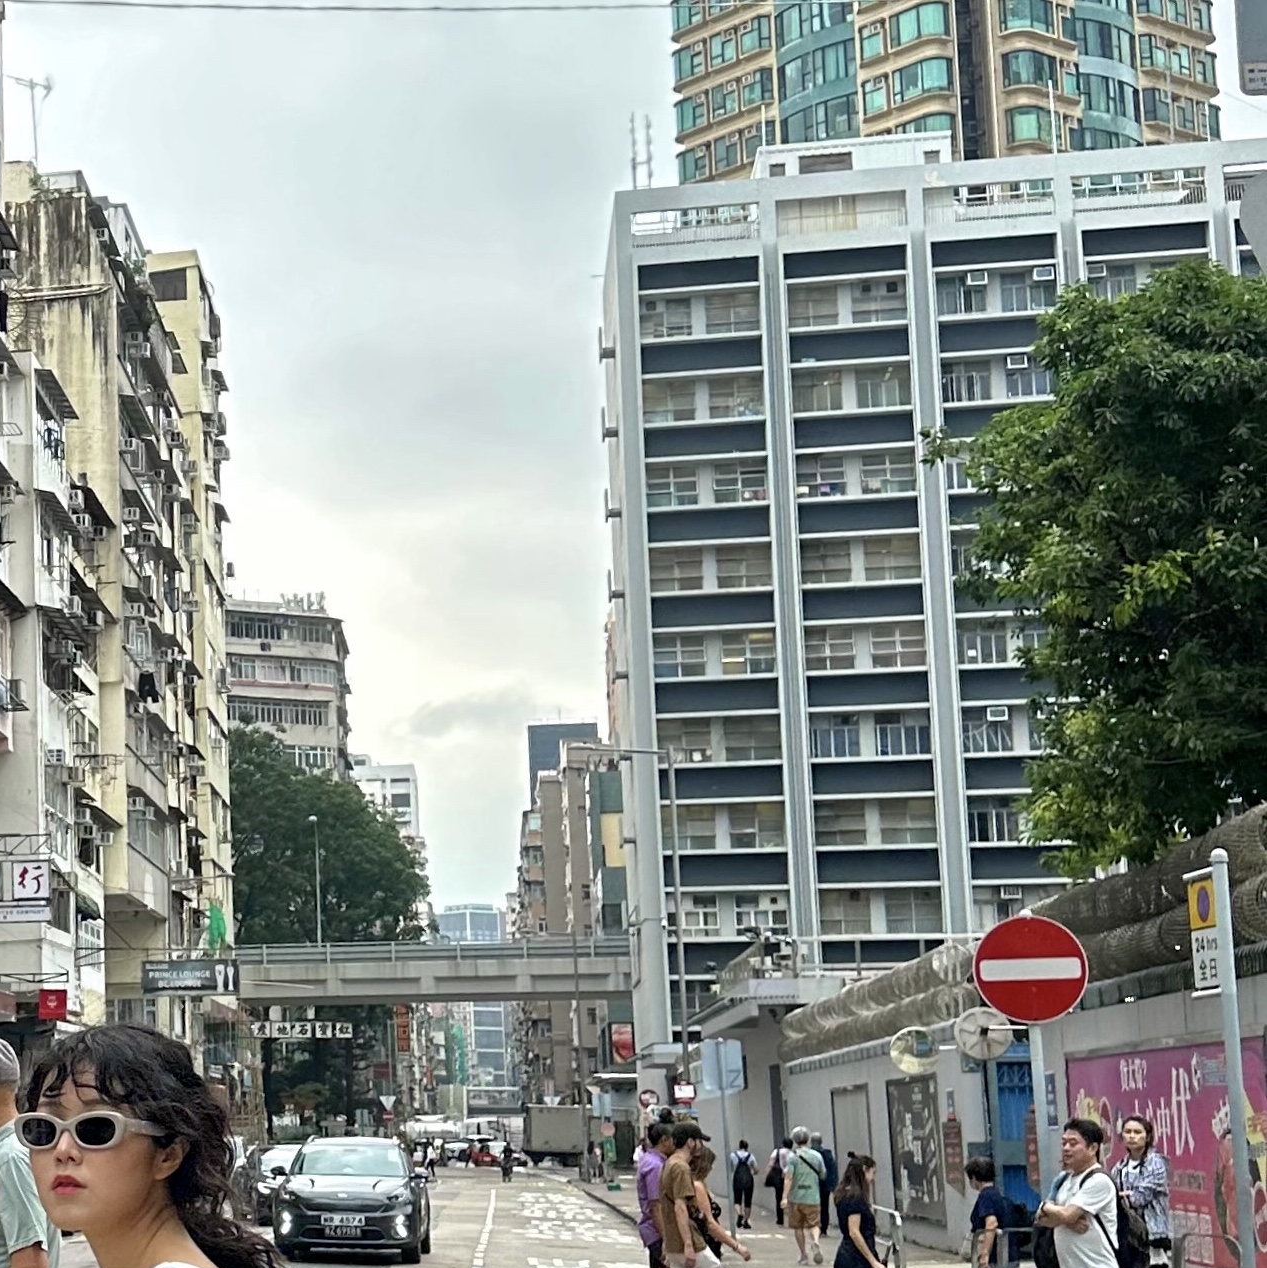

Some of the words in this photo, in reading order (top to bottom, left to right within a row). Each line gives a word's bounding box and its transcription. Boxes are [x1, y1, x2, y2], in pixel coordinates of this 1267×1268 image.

[1194, 937, 1205, 953] 24
[179, 970, 211, 979] LOUNGE
[1199, 958, 1218, 981] 全日
